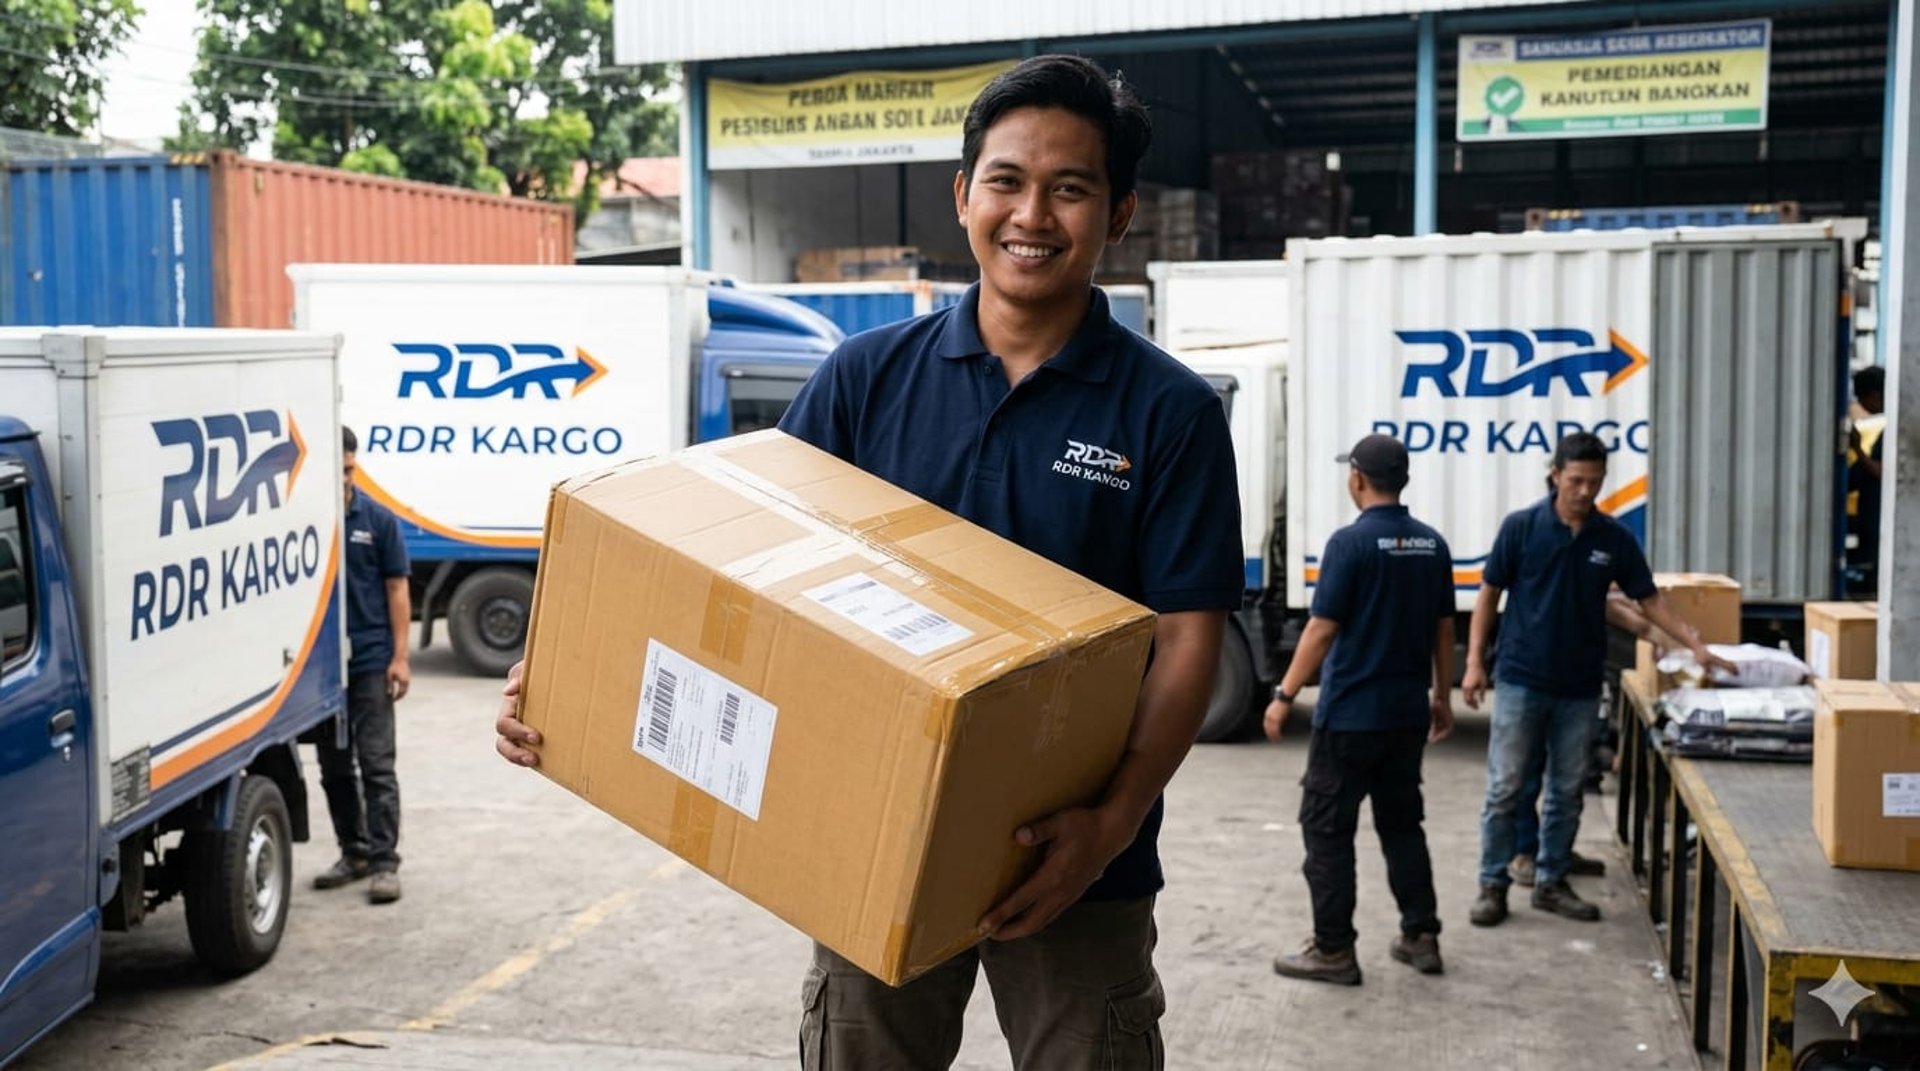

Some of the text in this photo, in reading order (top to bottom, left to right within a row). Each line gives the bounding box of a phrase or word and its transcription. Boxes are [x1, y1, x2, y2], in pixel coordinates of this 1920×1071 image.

[391, 343, 566, 399] RDR
[1393, 328, 1596, 398] RDR
[367, 425, 623, 455] RDR KARGO
[1064, 439, 1122, 471] RDR
[151, 409, 282, 538] RDR
[1051, 460, 1082, 477] RDR
[131, 524, 320, 642] RDR KARGO
